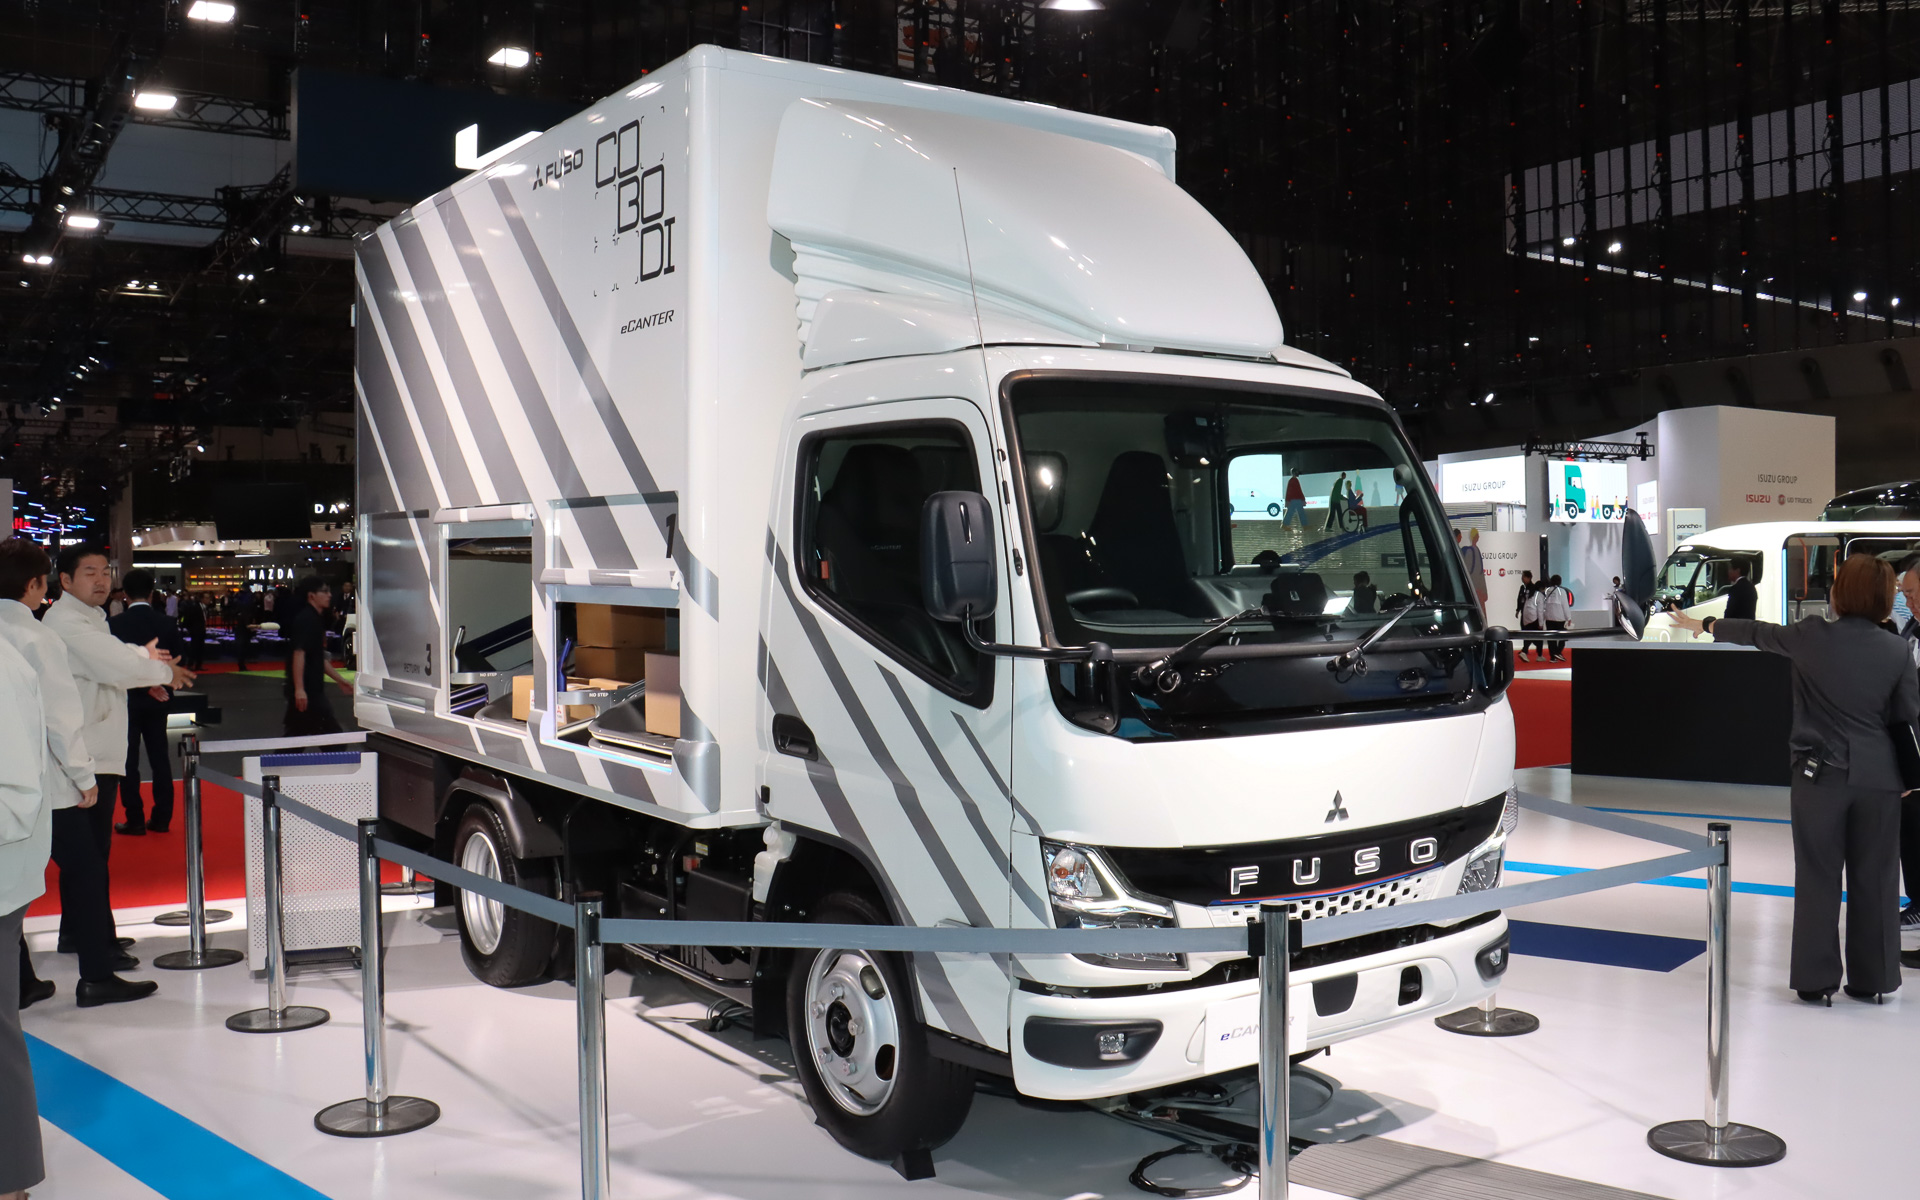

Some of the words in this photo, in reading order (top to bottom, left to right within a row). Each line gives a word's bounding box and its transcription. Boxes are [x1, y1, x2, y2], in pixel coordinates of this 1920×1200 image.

[545, 148, 584, 184] FUSO
[621, 309, 675, 335] eCANTER
[1462, 484, 1482, 492] ISUZU
[1483, 480, 1506, 490] GROUP
[1757, 474, 1776, 483] ISUZU
[1777, 475, 1798, 484] GROUP
[1746, 494, 1771, 503] ISUZU
[666, 513, 676, 558] 1
[1481, 552, 1497, 560] SUZU
[1497, 552, 1518, 560] GROUP
[248, 568, 294, 580] MAZDA
[424, 643, 432, 676] 3
[1229, 836, 1439, 895] FUSO
